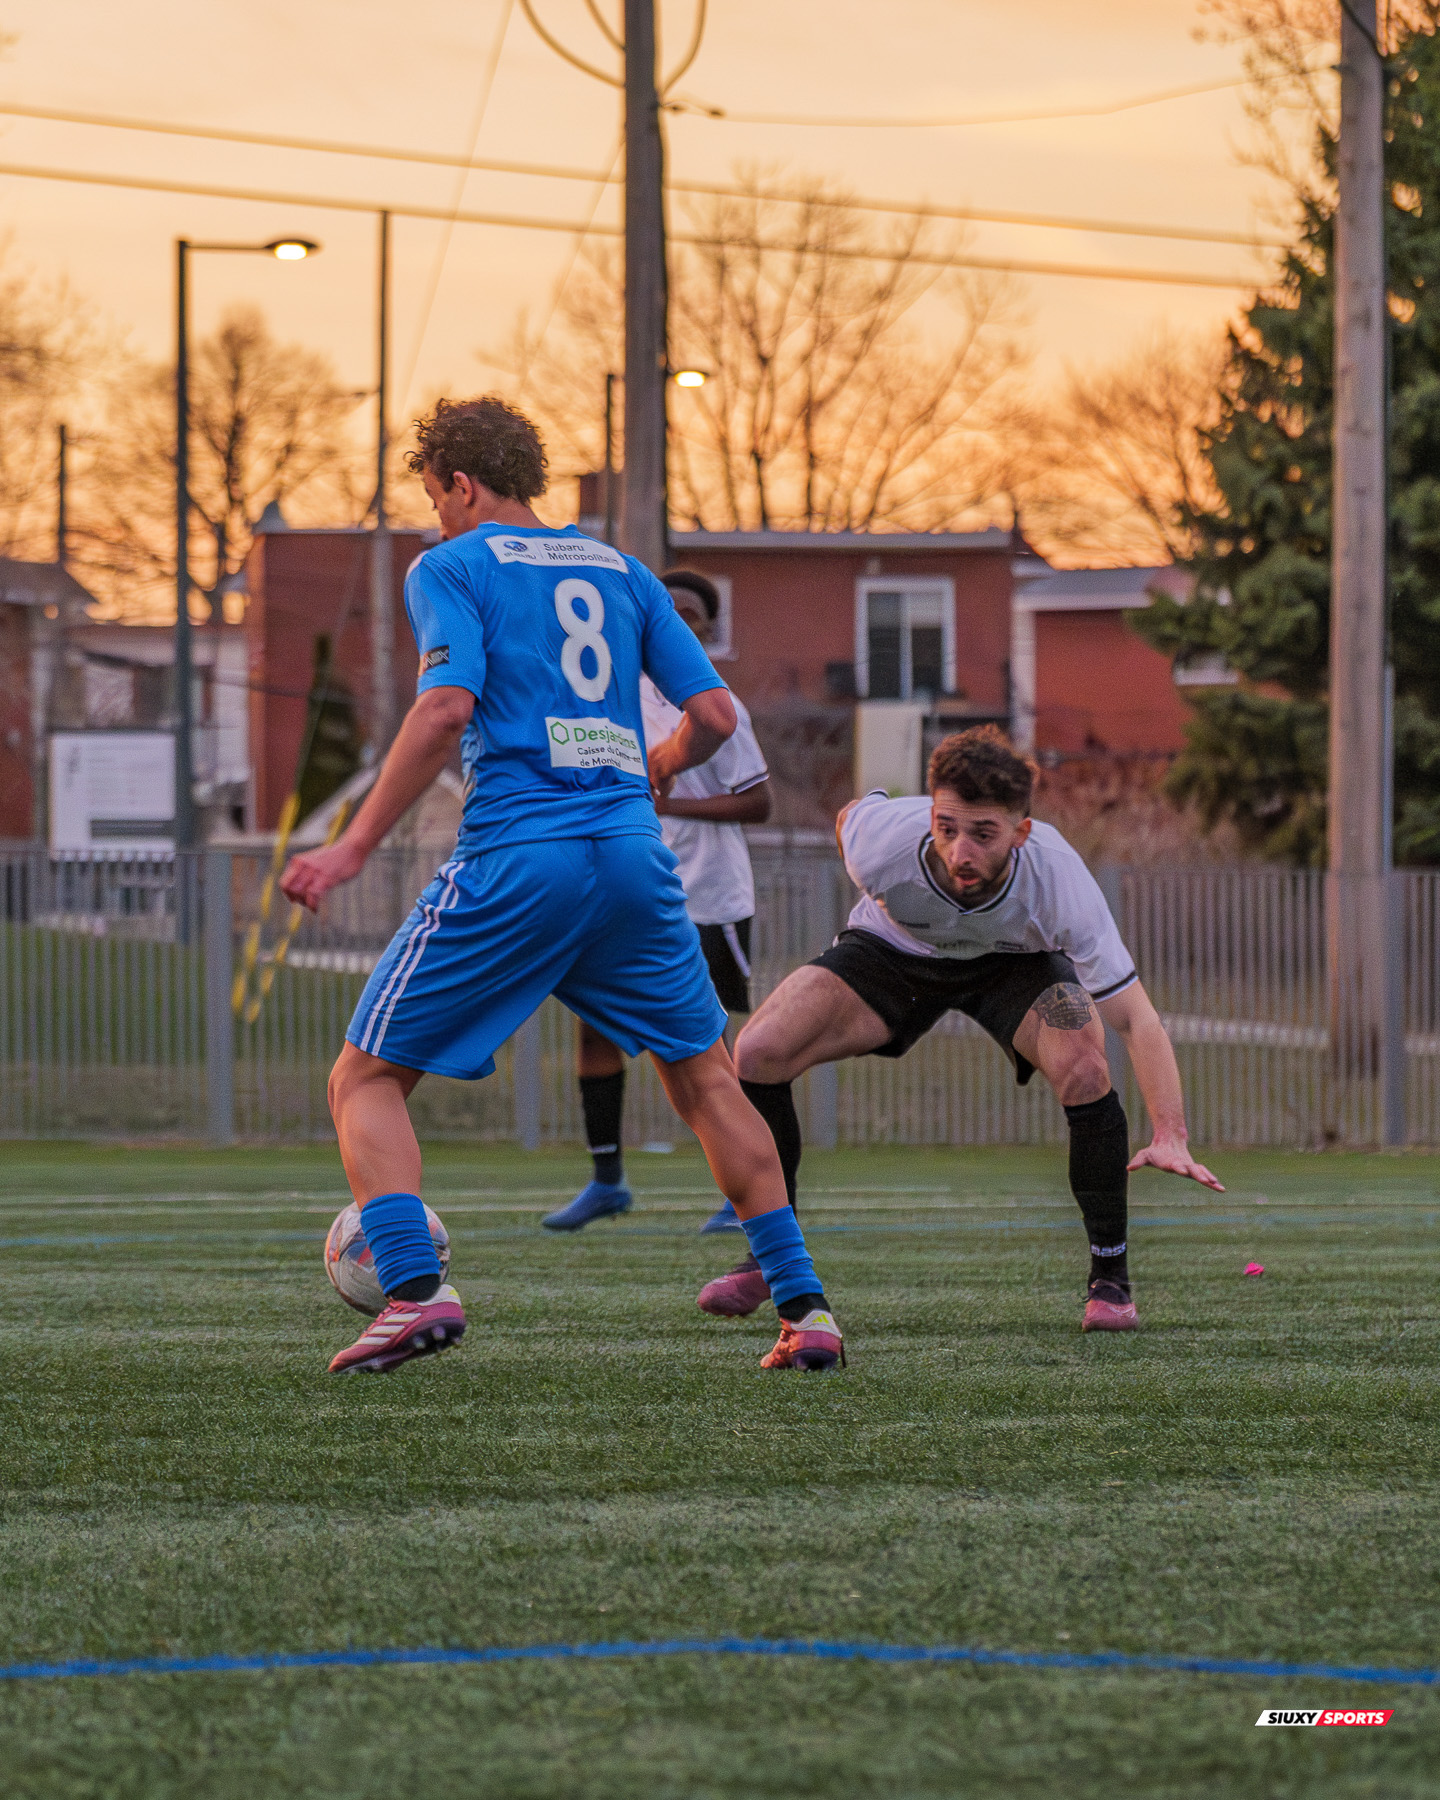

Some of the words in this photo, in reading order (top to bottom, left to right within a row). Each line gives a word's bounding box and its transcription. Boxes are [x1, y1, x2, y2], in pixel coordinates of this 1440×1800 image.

[543, 543, 584, 552] Subaru
[554, 578, 613, 703] 8
[573, 725, 637, 750] Desjans
[577, 746, 606, 756] Caisse
[580, 758, 590, 767] de
